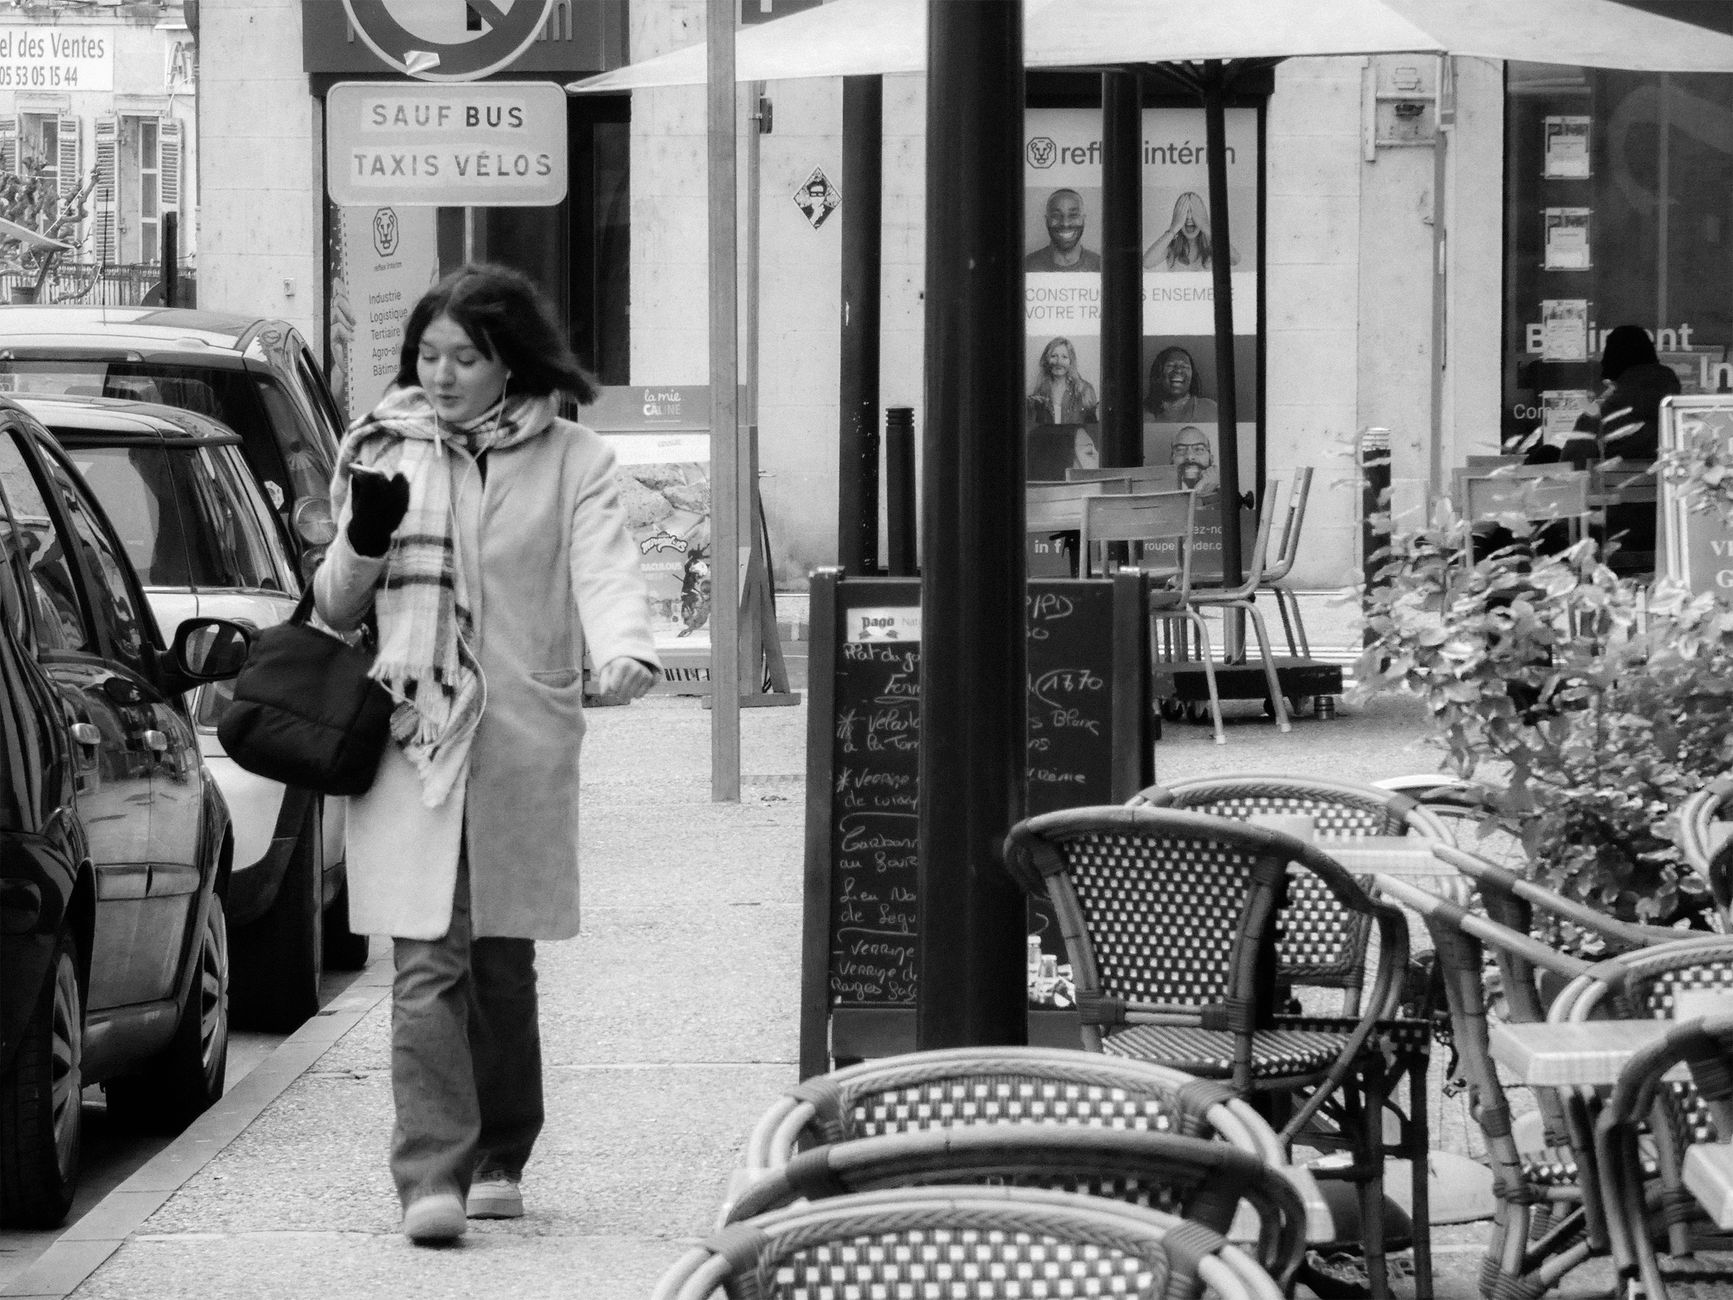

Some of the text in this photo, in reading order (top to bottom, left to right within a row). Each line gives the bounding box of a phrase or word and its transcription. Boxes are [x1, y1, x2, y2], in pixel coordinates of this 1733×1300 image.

[18, 31, 44, 58] des
[50, 32, 104, 58] Ventes
[16, 66, 28, 86] 53
[31, 66, 45, 86] 05
[49, 66, 60, 86] 15
[64, 66, 78, 86] 44
[372, 104, 524, 128] SAUF BUS
[353, 151, 552, 177] TAXIS VÉLOS
[369, 290, 401, 305] Industrie
[369, 307, 408, 325] Logistique
[1025, 305, 1074, 320] VOTRE
[371, 326, 401, 341] Tertiaire
[644, 388, 681, 402] la mie
[861, 616, 895, 631] pago
